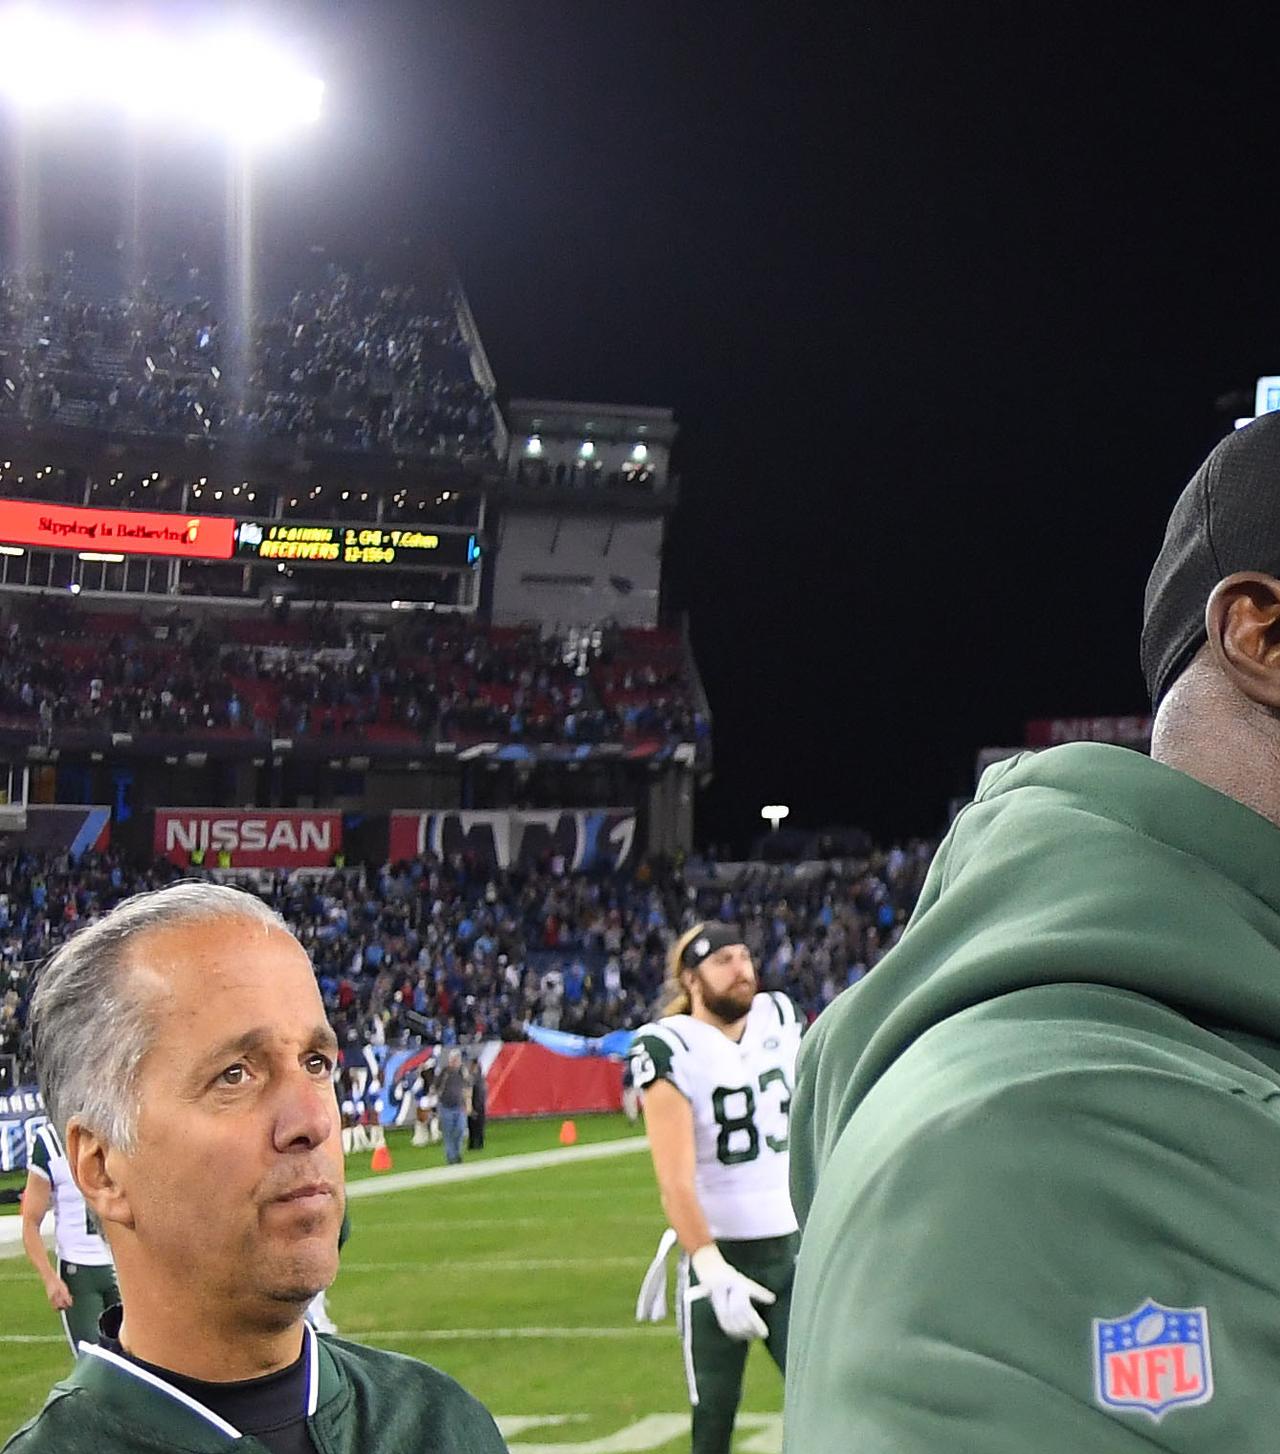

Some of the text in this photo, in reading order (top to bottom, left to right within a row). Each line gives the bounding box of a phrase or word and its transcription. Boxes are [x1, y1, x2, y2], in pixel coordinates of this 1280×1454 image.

[38, 516, 98, 539] Sipping
[100, 523, 113, 537] is
[166, 819, 330, 852] NISSAN
[712, 1069, 789, 1166] 83
[1108, 1346, 1199, 1401] NFL
